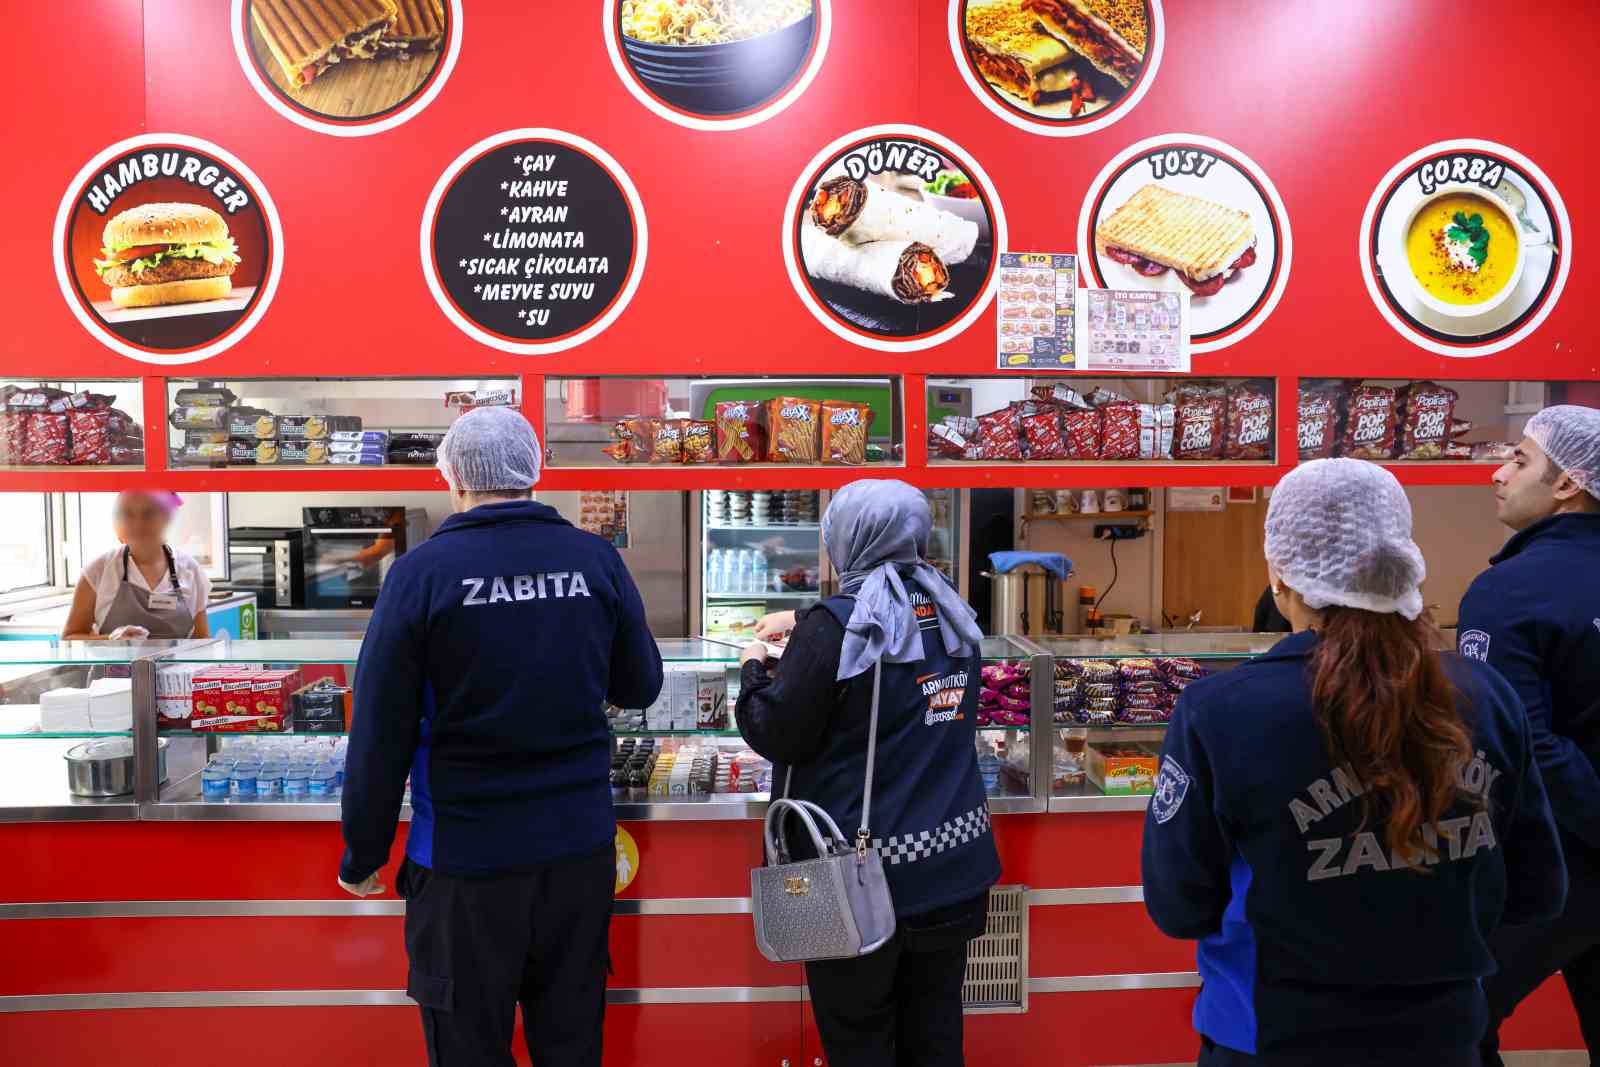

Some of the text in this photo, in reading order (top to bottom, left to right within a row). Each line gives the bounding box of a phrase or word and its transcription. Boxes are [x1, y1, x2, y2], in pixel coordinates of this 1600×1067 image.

[846, 144, 941, 181] DÖNER
[1150, 150, 1215, 177] TOST
[1420, 157, 1503, 193] ÇORBA
[88, 152, 249, 213] HAMBURGER
[524, 252, 609, 279] ÇİKOLATA
[547, 282, 595, 300] SUYU
[462, 571, 592, 607] ZABITA
[1307, 810, 1498, 881] ZAITA
